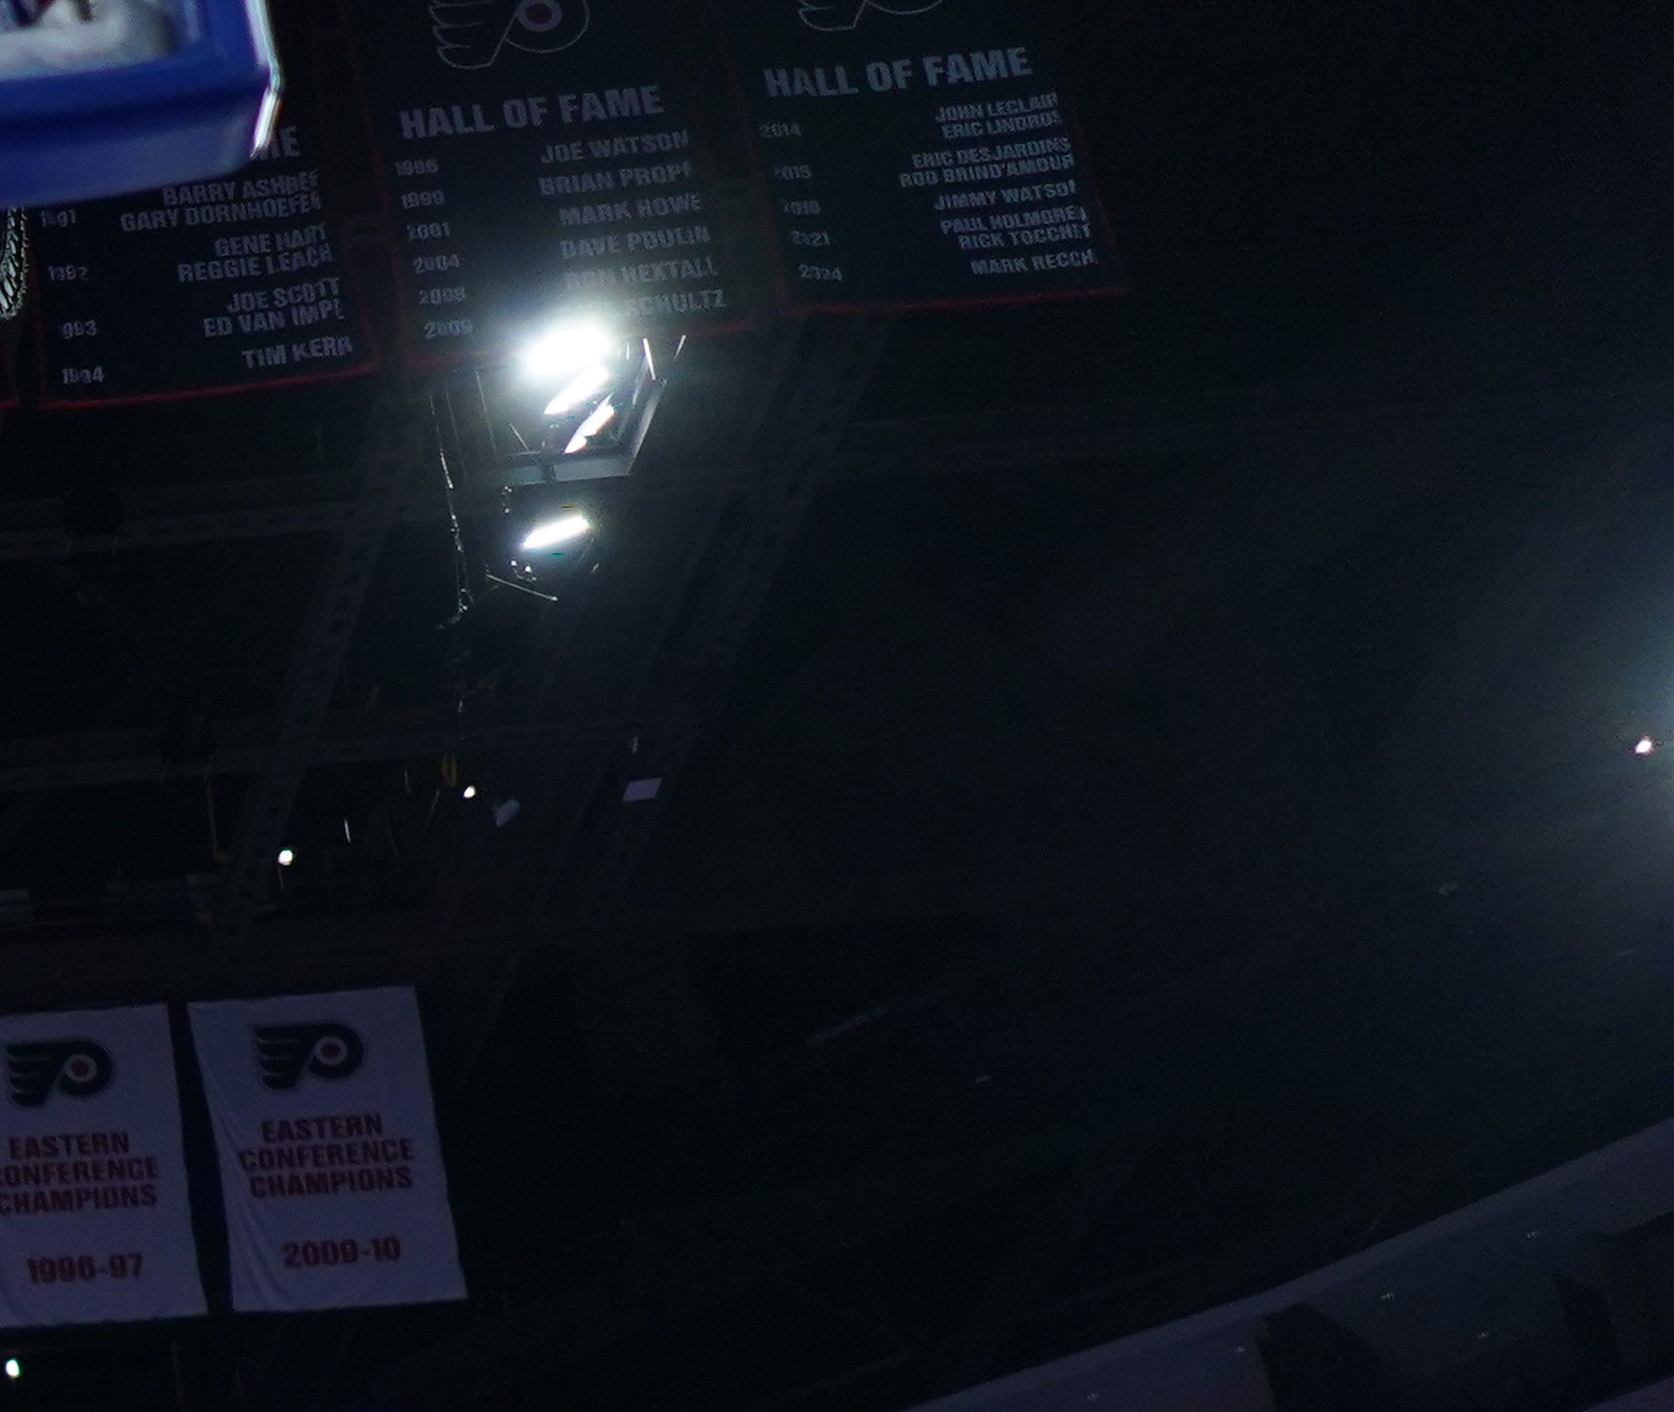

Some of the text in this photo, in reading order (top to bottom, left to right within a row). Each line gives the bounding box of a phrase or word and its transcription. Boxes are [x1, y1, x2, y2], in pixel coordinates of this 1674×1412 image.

[762, 47, 1032, 99] HALL OF FAME
[399, 84, 665, 140] HALL OF FAME
[935, 102, 983, 123] JOHN
[540, 128, 690, 164] JOE WATSON
[911, 137, 1072, 169] ERIC DESJARDINS
[538, 170, 615, 197] BRIAN
[899, 153, 1075, 188] ROD BRIND'AMOUR
[163, 181, 237, 206] BARRY
[558, 192, 703, 227] MARK HOWE
[934, 191, 997, 211] JIMMY
[120, 208, 179, 232] GARY
[214, 222, 328, 257] GENE HART
[627, 224, 711, 252] POULIN
[958, 230, 1004, 250] RICK
[178, 243, 334, 283] REGGIE LEACH
[971, 253, 1029, 275] MARK
[227, 277, 341, 313] JOE SCOTT
[203, 311, 285, 337] ED VAN
[242, 336, 354, 369] TIM KERR
[261, 1113, 384, 1143] EASTERN
[8, 1129, 130, 1160] EASTERN
[238, 1138, 414, 1172] CONFERENCE
[248, 1165, 414, 1200] CHAMPIONS
[282, 1236, 402, 1268] 2009-10
[27, 1252, 143, 1285] 1996-97
